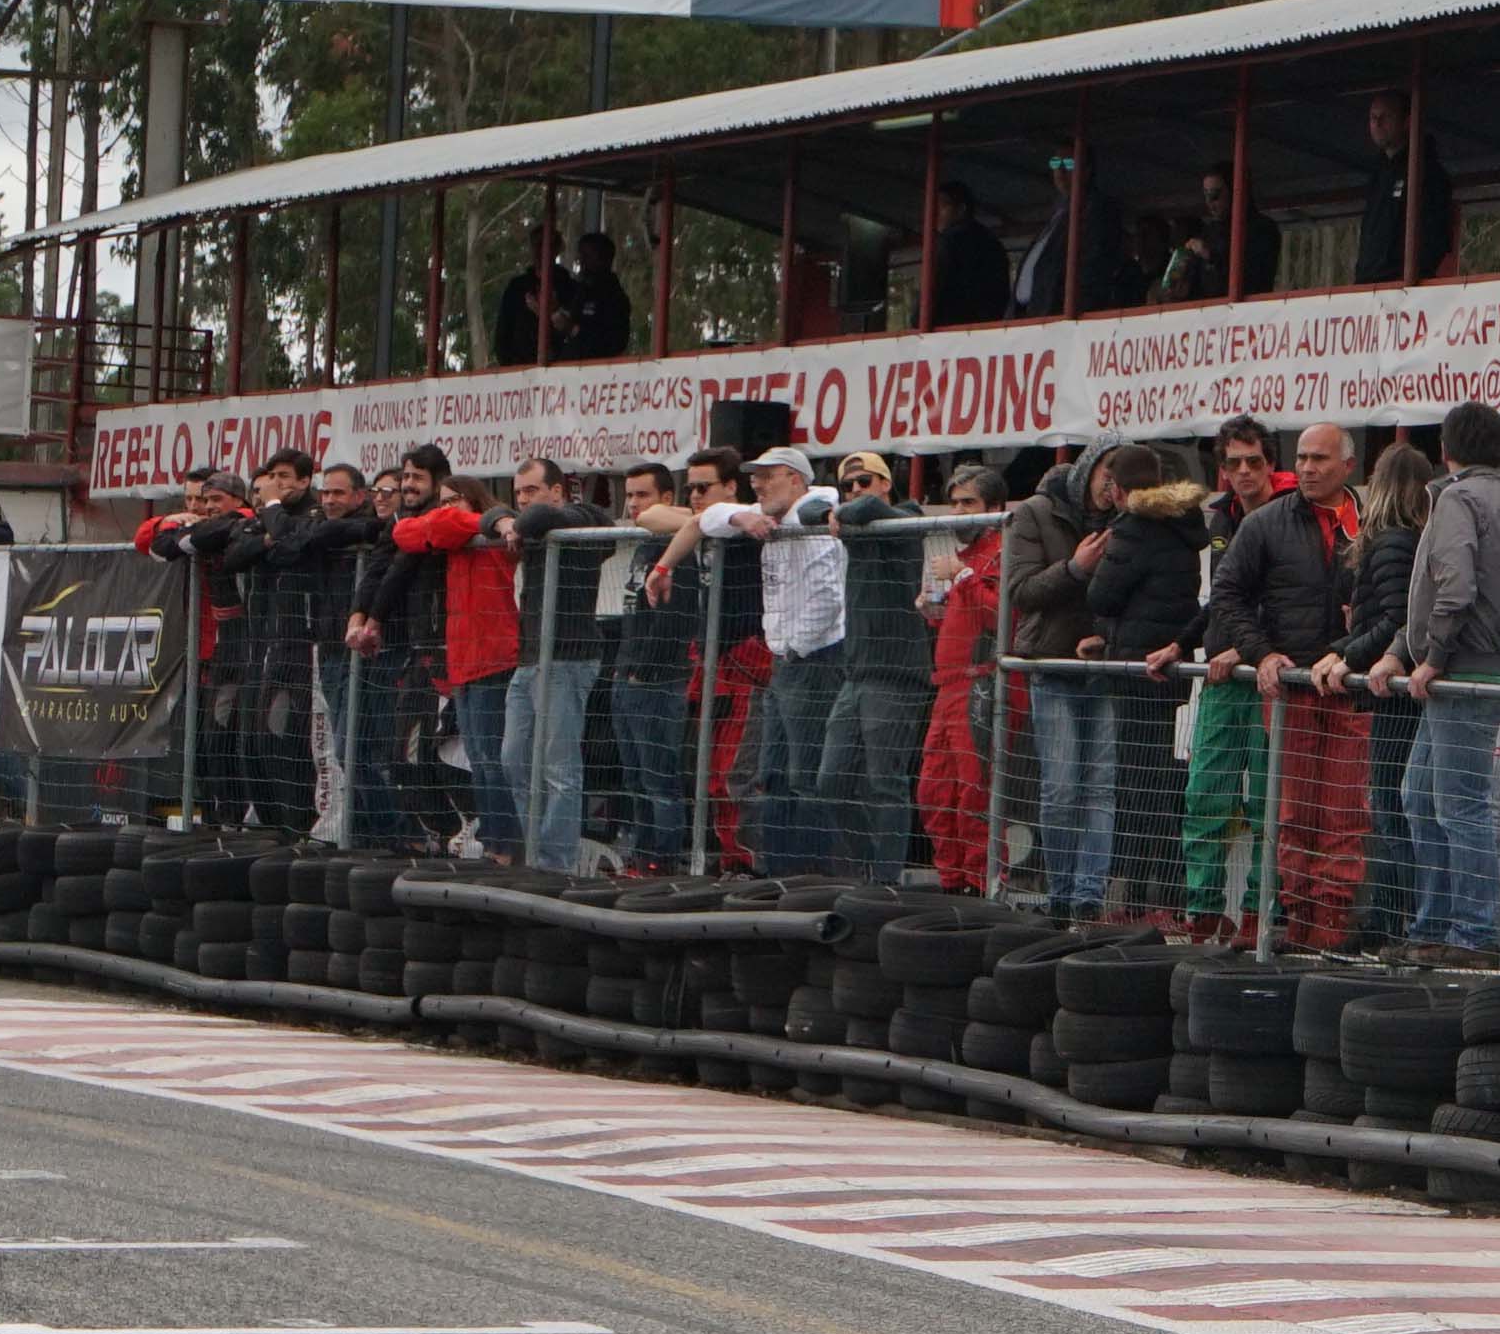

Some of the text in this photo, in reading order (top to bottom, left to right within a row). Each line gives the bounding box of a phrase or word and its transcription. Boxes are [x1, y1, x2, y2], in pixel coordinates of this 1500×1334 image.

[1087, 330, 1190, 379] MÁQUINAS
[1194, 327, 1214, 368] DE
[1220, 320, 1291, 366] VENDA
[434, 393, 481, 426] VENDA
[580, 373, 617, 416] CAFÉ
[620, 382, 629, 412] E
[868, 349, 1055, 441] VENDING
[1137, 388, 1166, 420] 061
[1250, 374, 1284, 412] 989
[1295, 372, 1328, 411] 270
[92, 422, 193, 489] REBELO
[457, 433, 481, 466] 989
[21, 699, 100, 723] EPARAÇÕES
